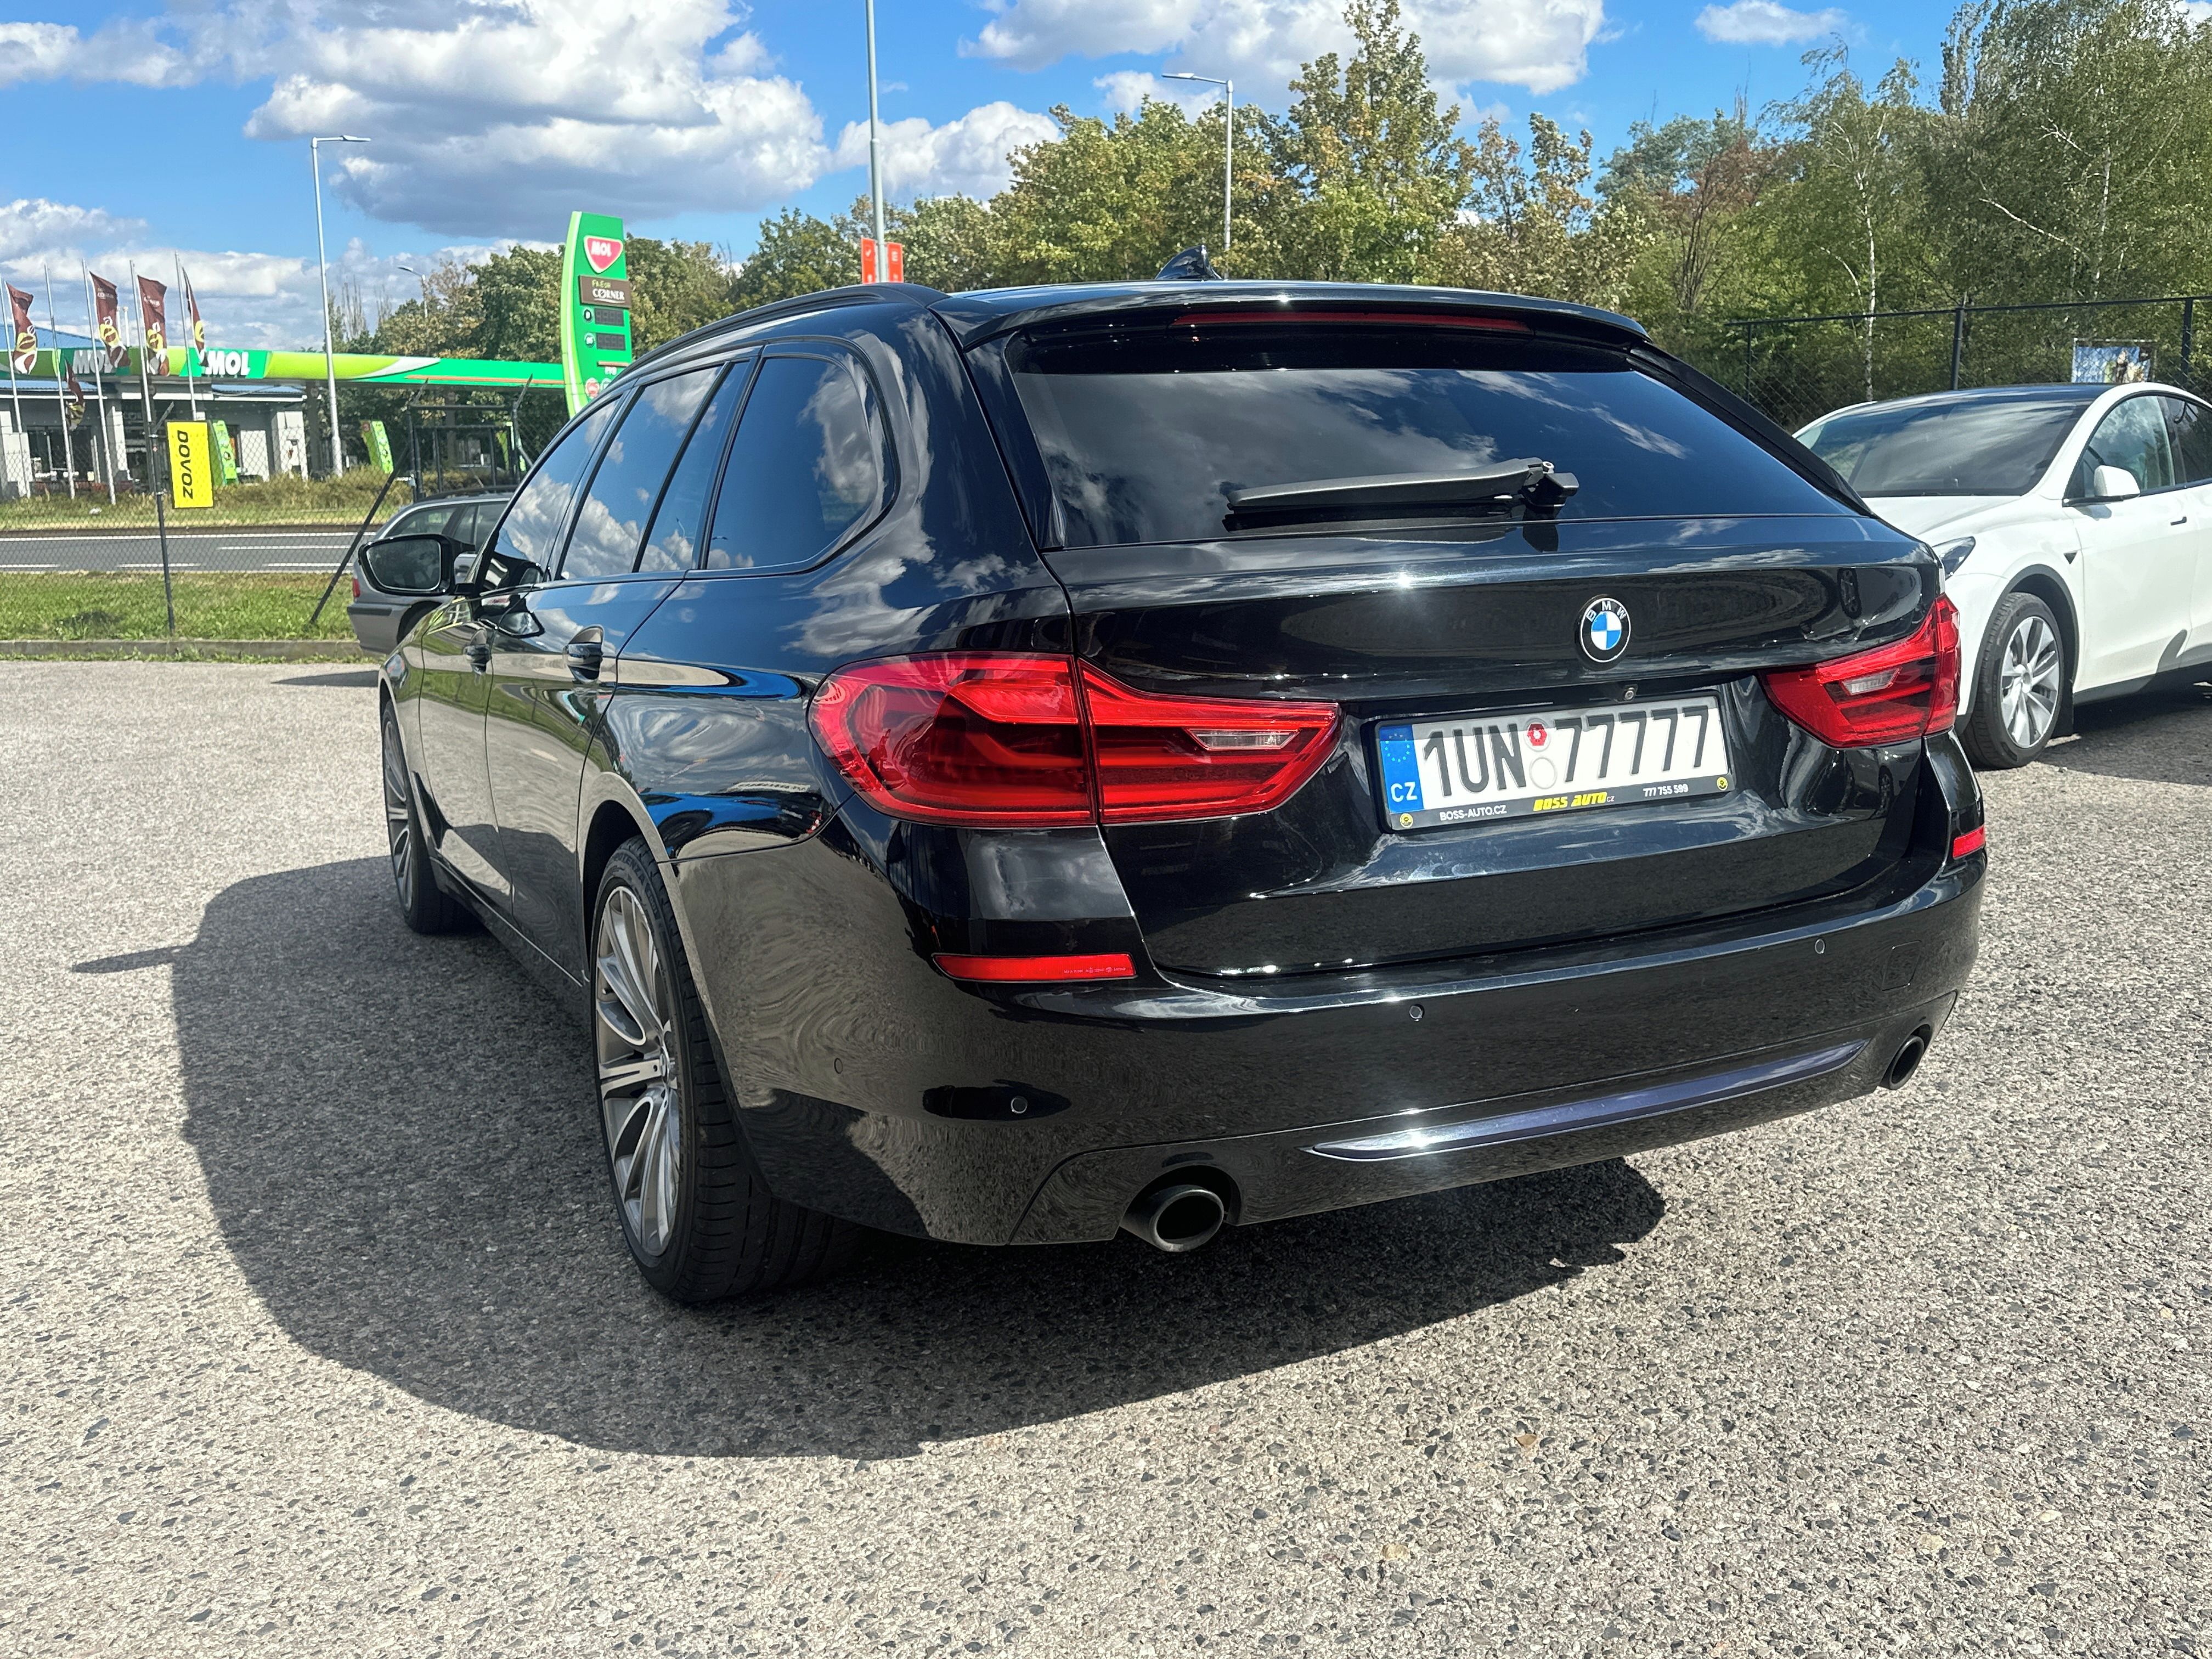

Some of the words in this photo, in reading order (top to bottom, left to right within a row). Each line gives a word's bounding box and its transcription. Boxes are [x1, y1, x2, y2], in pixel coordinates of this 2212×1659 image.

[591, 240, 612, 257] MOL
[592, 288, 624, 300] CORNER
[206, 351, 251, 375] MOL
[177, 430, 193, 499] DOVOZ
[1586, 601, 1627, 622] BMW
[1424, 723, 1527, 797] 1UN
[1554, 705, 1708, 782] 77777
[1391, 781, 1418, 802] CZ
[1643, 787, 1656, 797] 777
[1657, 786, 1672, 795] 755
[1673, 783, 1689, 794] 599
[1533, 795, 1568, 811] BOSS
[1570, 792, 1607, 808] AUTO
[1439, 804, 1507, 821] BOSS-AUTO.CZ
